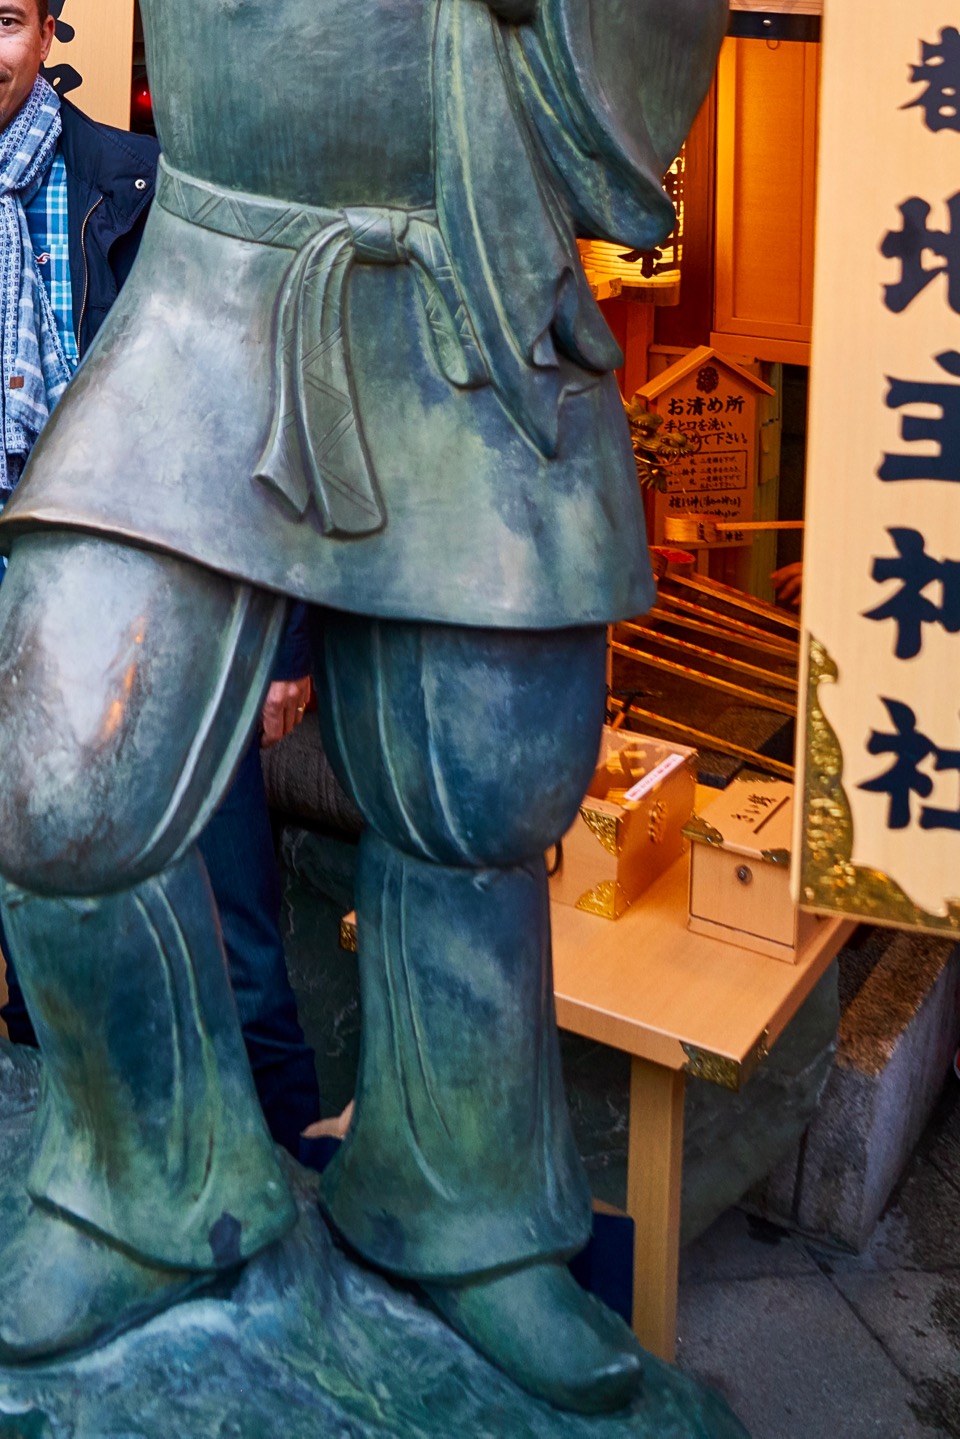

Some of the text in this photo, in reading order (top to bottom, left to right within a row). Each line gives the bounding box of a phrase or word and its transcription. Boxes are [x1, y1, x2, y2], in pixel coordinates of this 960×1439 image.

[668, 396, 746, 415] お清め所
[664, 417, 733, 433] 手と口を洗い
[683, 432, 748, 445] めて下さい。
